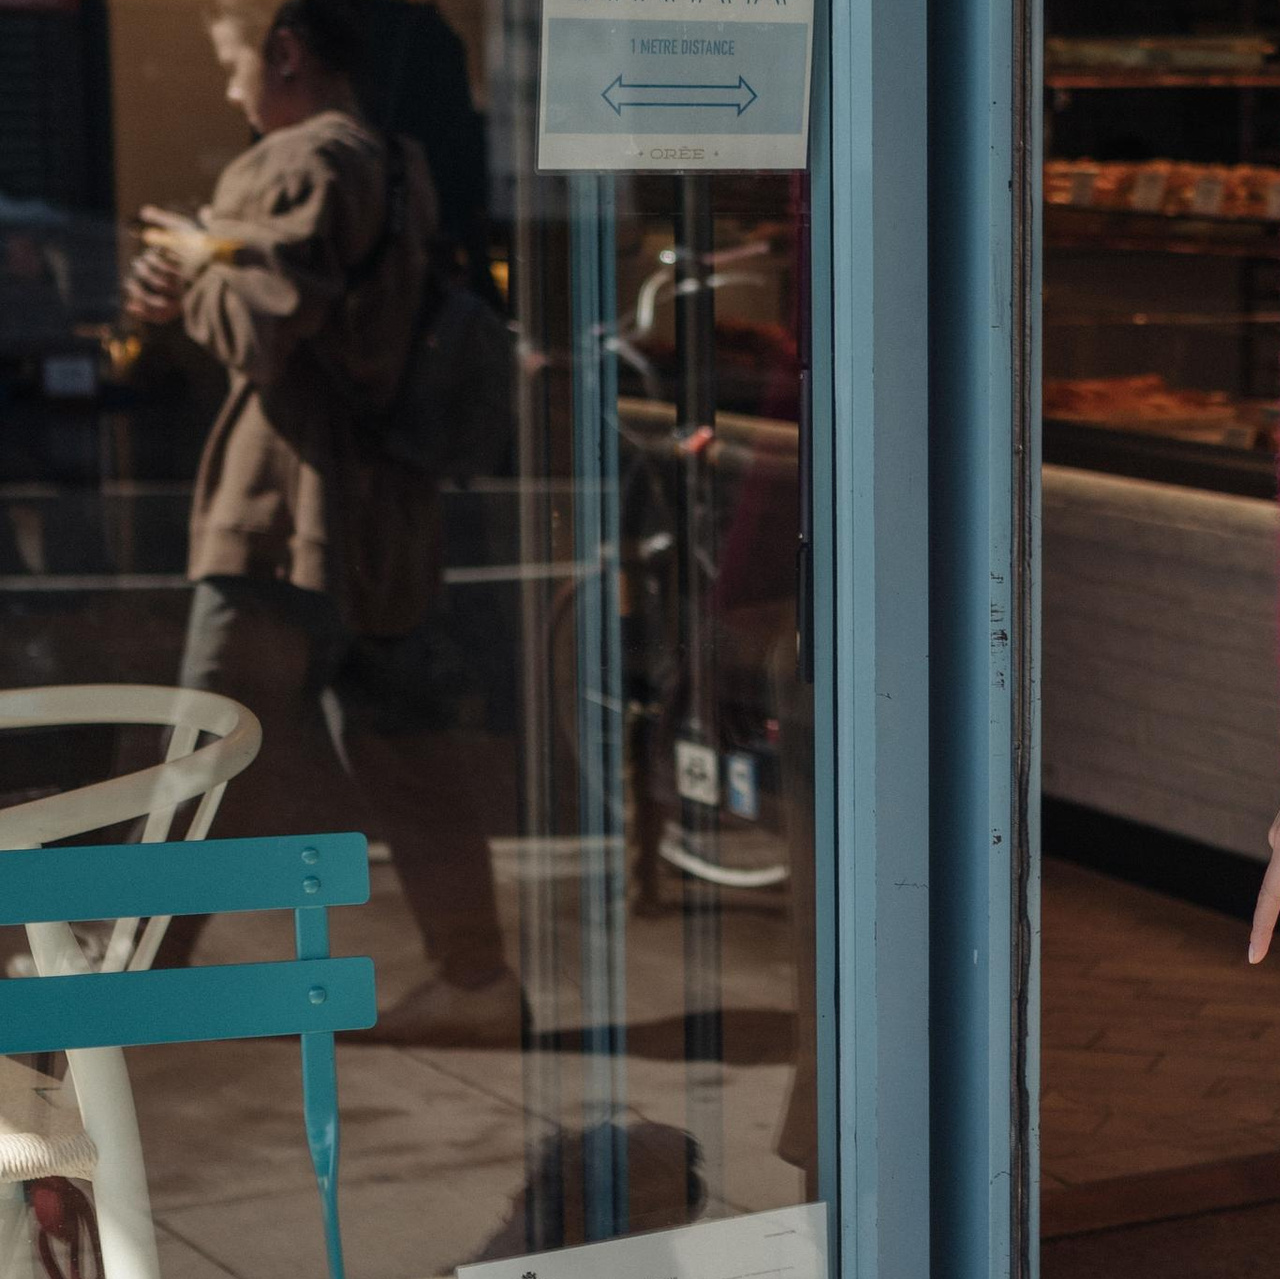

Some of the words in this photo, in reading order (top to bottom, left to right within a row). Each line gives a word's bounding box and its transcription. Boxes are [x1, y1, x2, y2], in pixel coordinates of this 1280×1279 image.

[630, 39, 636, 55] 1
[640, 39, 678, 56] METRE
[681, 39, 735, 56] DISTANCE
